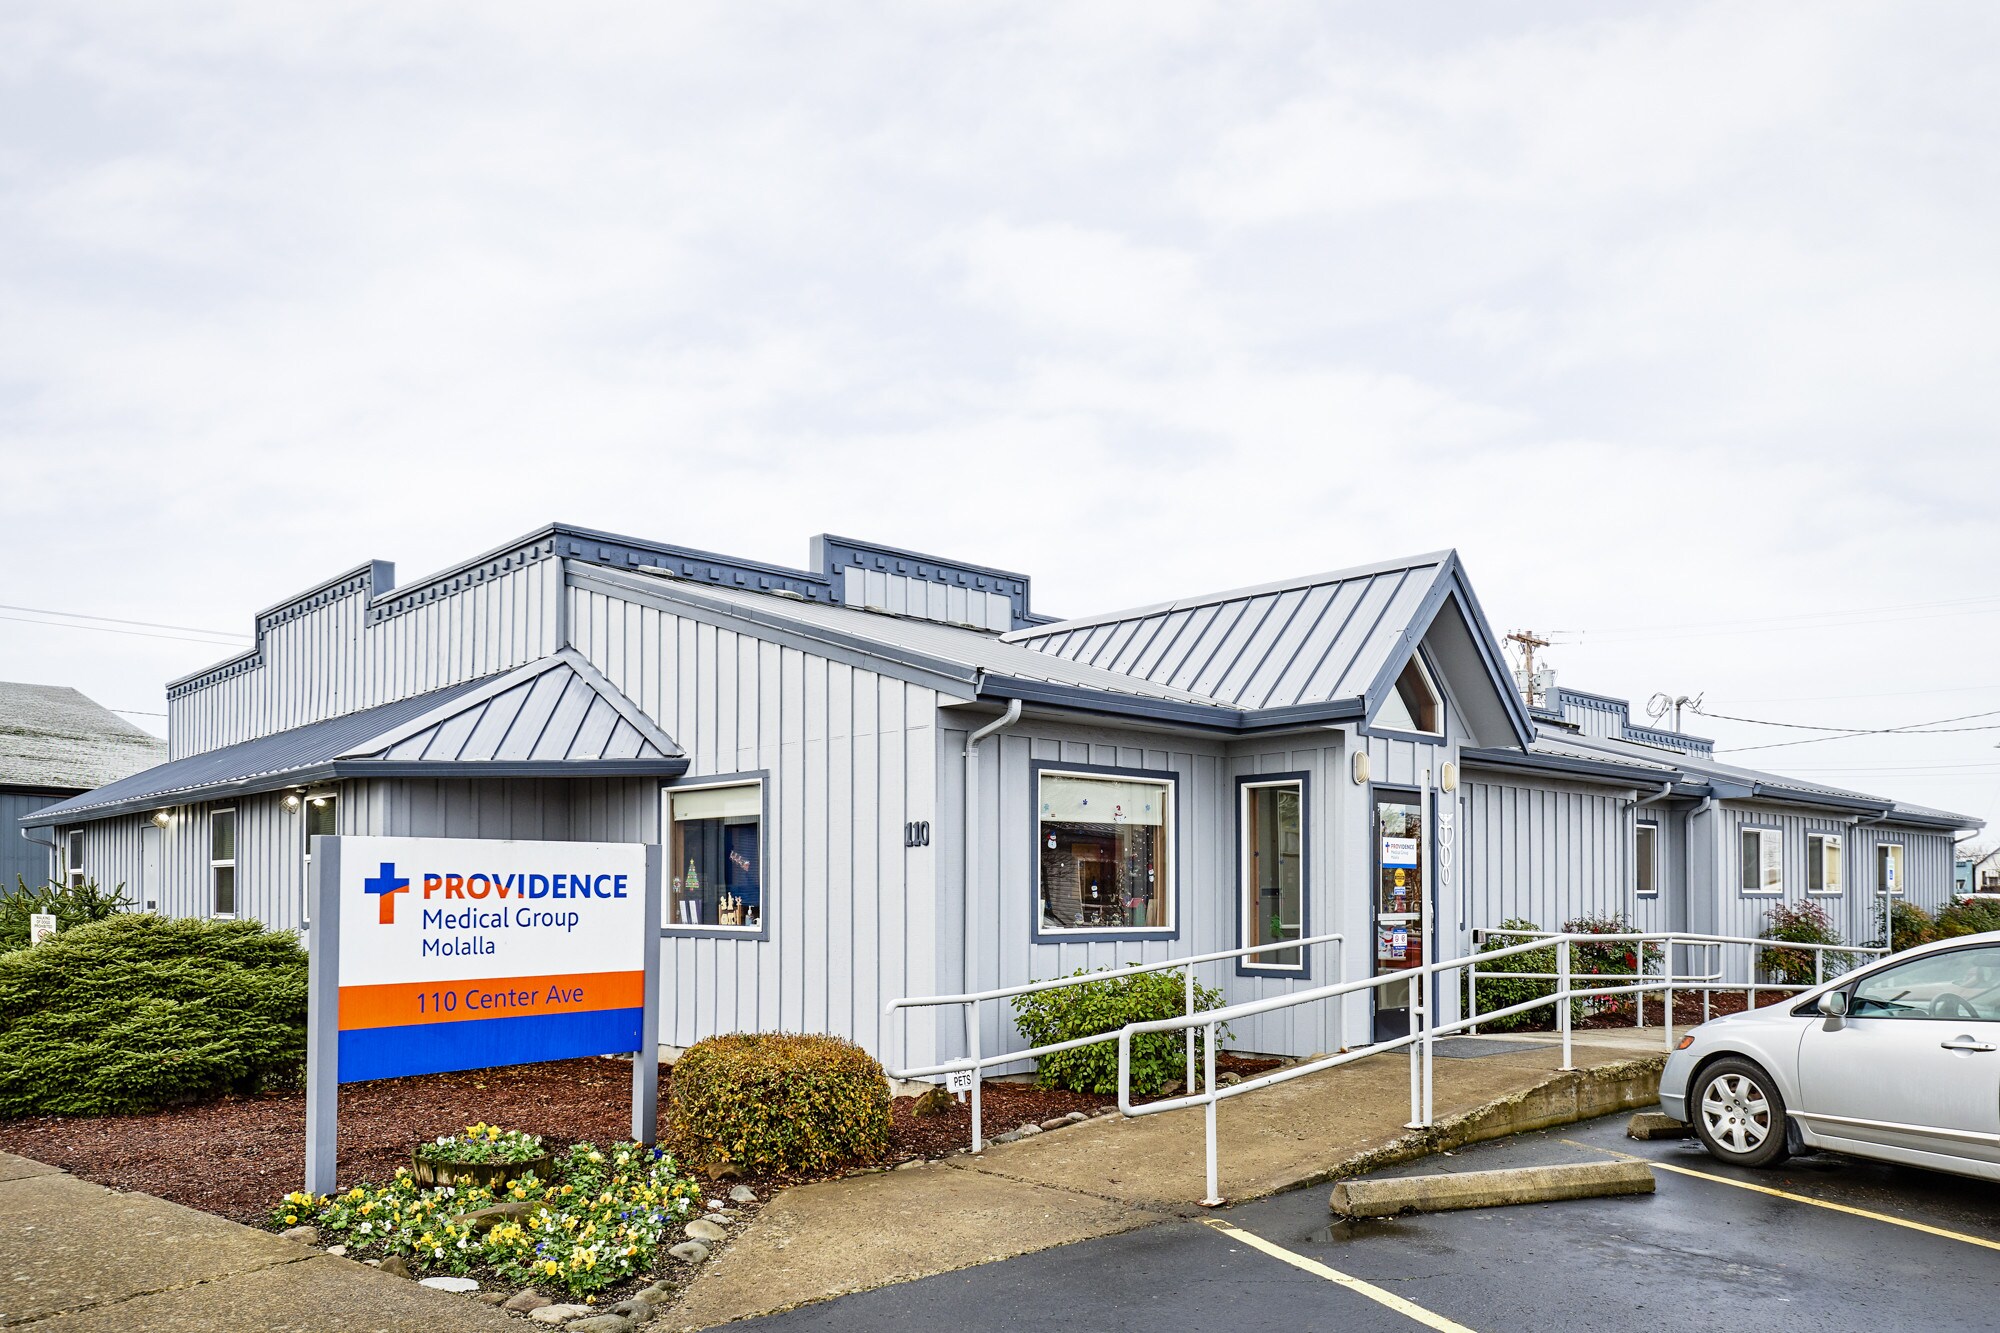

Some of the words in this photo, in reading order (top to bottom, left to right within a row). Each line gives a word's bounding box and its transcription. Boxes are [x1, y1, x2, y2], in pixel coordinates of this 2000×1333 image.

[904, 821, 930, 847] 110
[423, 873, 628, 899] PROVIDENCE
[422, 907, 509, 930] Medical
[515, 908, 579, 932] Group
[422, 936, 495, 957] Molalla
[417, 991, 457, 1013] 110
[465, 988, 539, 1011] Center
[545, 984, 585, 1005] Ave
[953, 1074, 972, 1087] PETS
